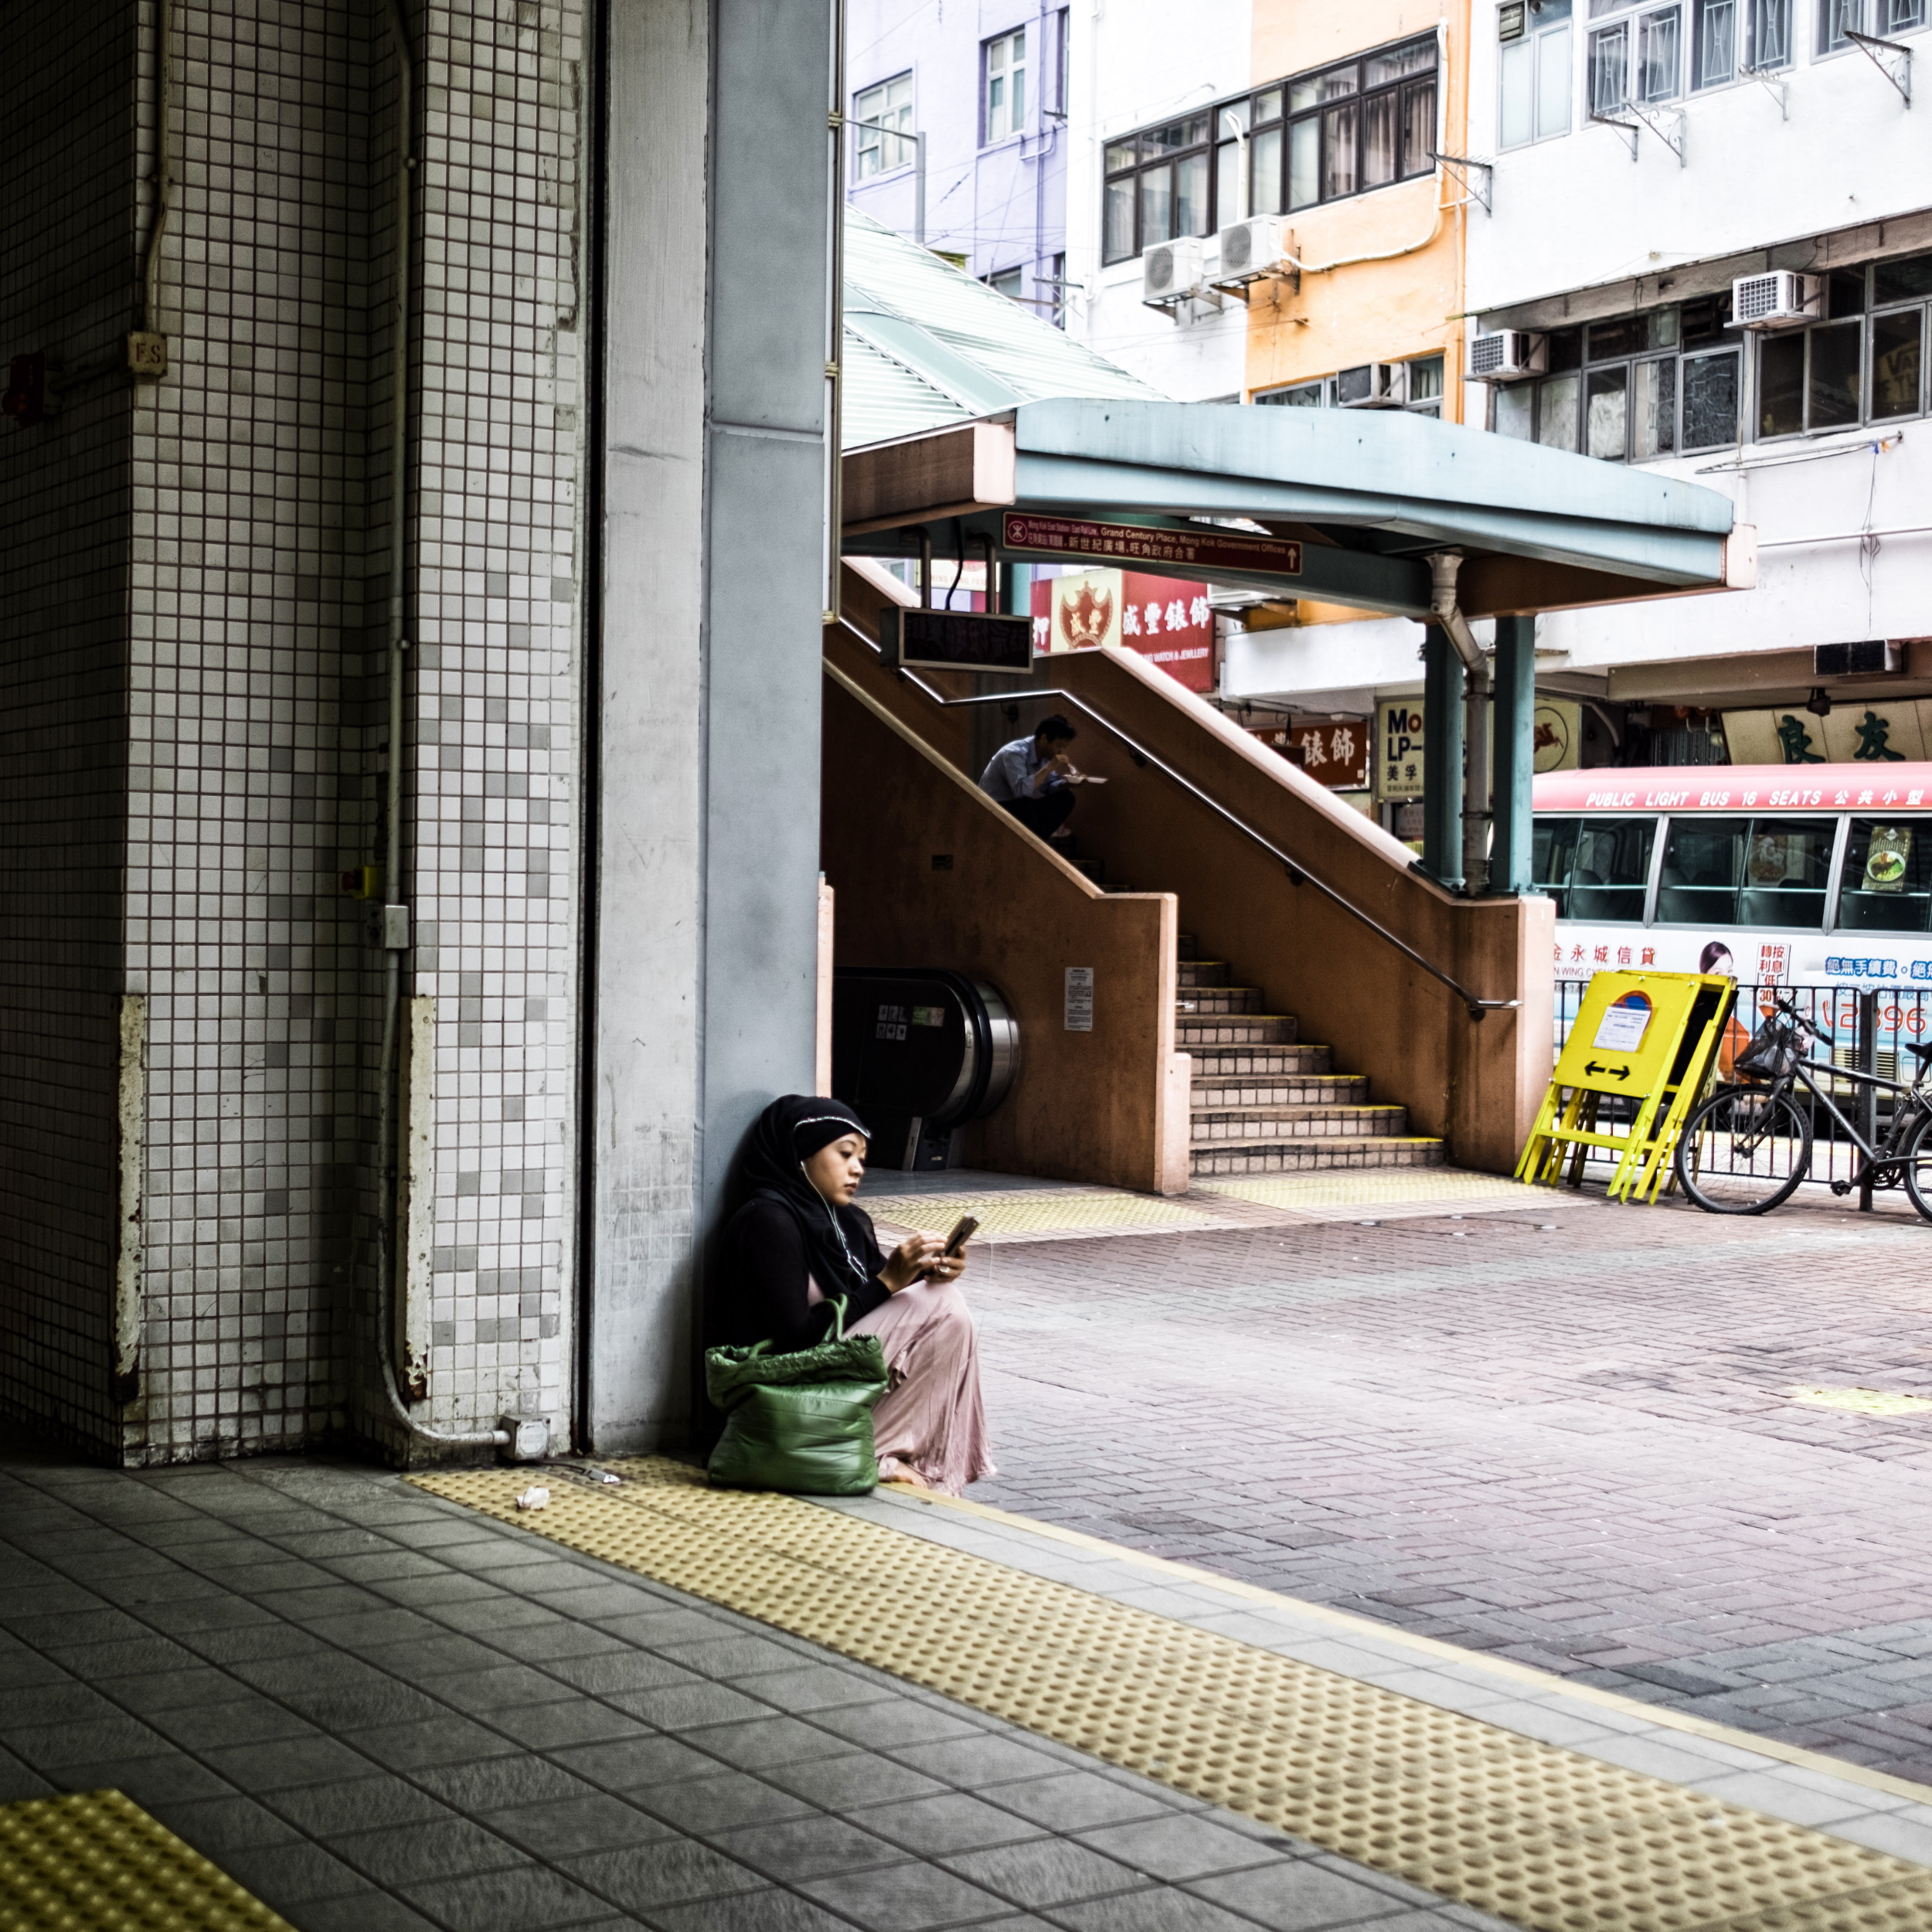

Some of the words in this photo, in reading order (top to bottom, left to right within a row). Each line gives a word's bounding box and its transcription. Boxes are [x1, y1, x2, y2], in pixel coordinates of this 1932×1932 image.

[1028, 520, 1039, 531] Mong
[1100, 527, 1124, 539] Grand
[1125, 529, 1155, 543] Century
[1179, 535, 1199, 547] Mong
[1201, 537, 1215, 546] Kok
[1216, 539, 1260, 552] Government
[1261, 543, 1286, 554] Offices
[1153, 651, 1174, 662] WATCH
[1174, 650, 1179, 661] &
[1387, 764, 1417, 781] 美孚
[1585, 792, 1636, 808] PUBLIC
[1645, 791, 1690, 807] LIGHT
[1699, 791, 1730, 806] BUS
[1741, 791, 1758, 806] 16
[1769, 790, 1822, 806] SEATS
[1561, 967, 1583, 978] WING
[1759, 959, 1783, 973] 利息
